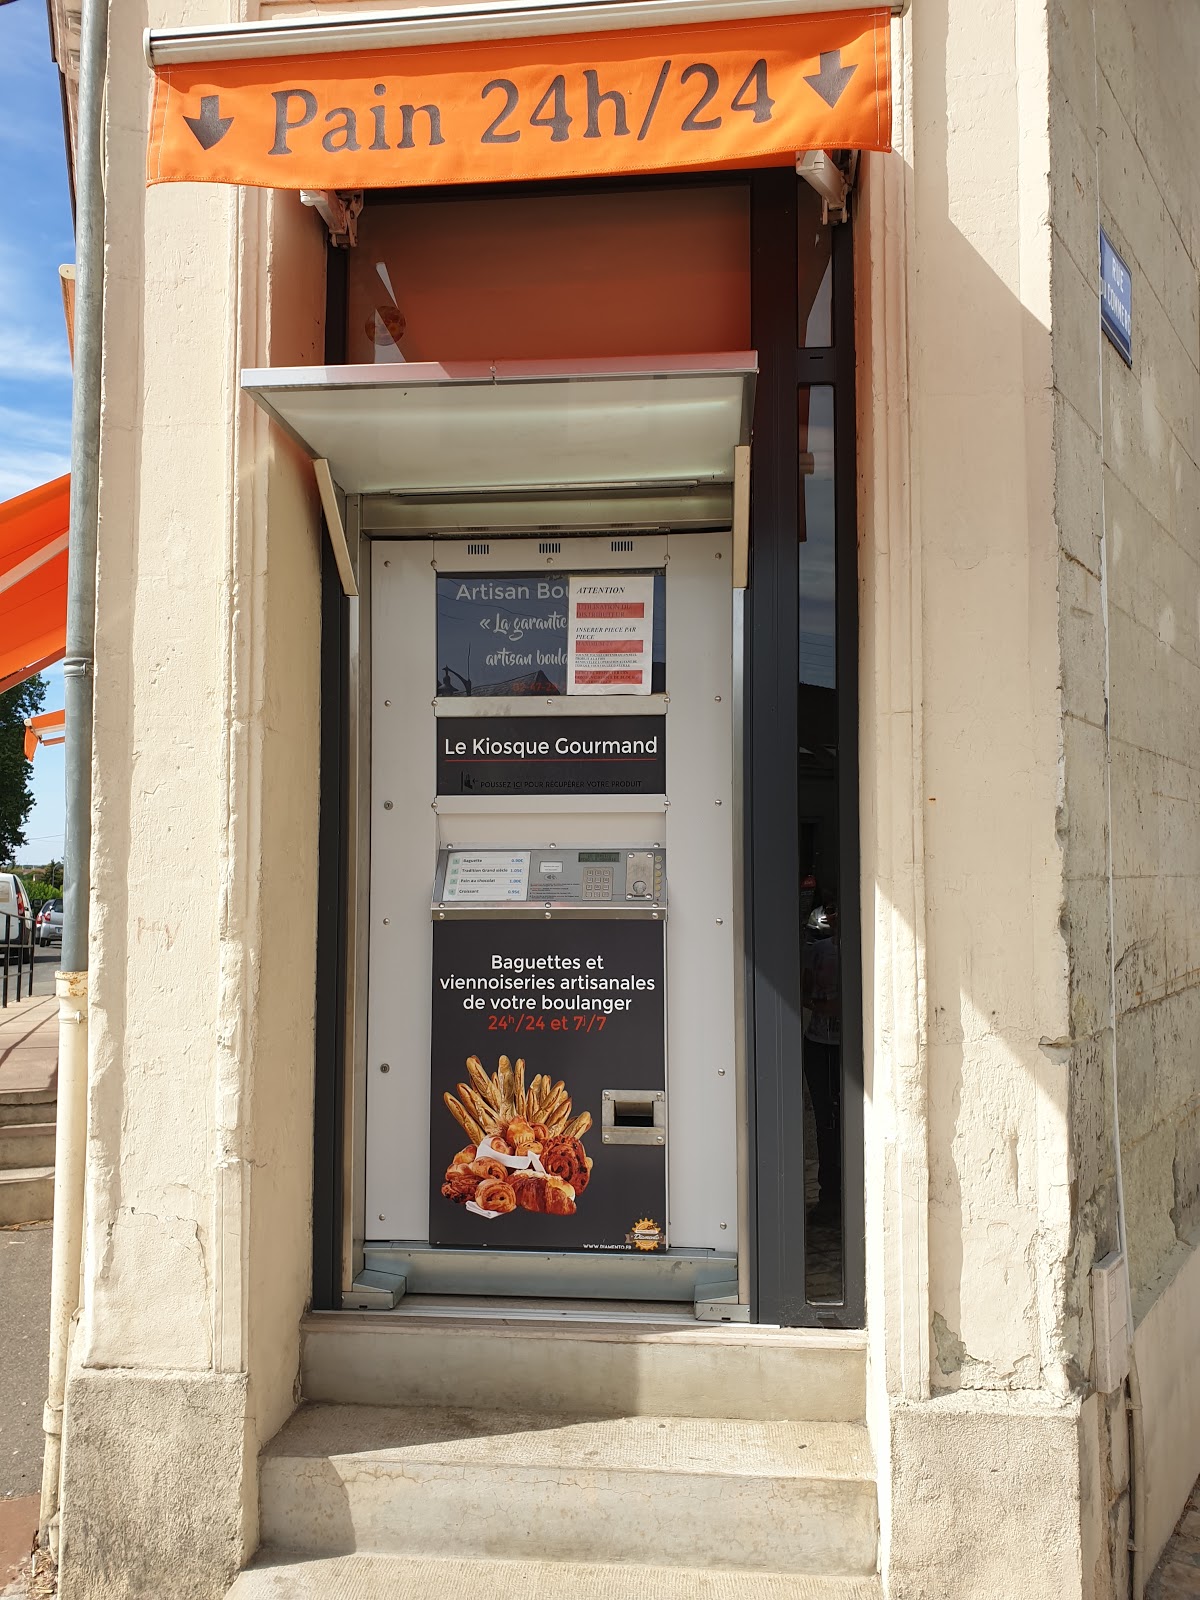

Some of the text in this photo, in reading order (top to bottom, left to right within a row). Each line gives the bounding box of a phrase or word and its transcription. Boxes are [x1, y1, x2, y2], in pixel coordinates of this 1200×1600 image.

[269, 58, 776, 155] Pain 24h/24
[1111, 257, 1124, 293] RUE
[456, 582, 529, 600] Artisan
[576, 586, 625, 594] ATTENTION
[492, 613, 511, 635] La
[508, 611, 568, 642] garantie
[485, 647, 532, 667] artisan
[445, 735, 658, 758] Le Kiosque Gourmand
[491, 955, 604, 973] Baguettes et
[439, 974, 655, 990] viennoiseries artisanales
[463, 995, 632, 1014] de votre boulanger
[488, 1014, 607, 1032] 24h/24 et 7j/7
